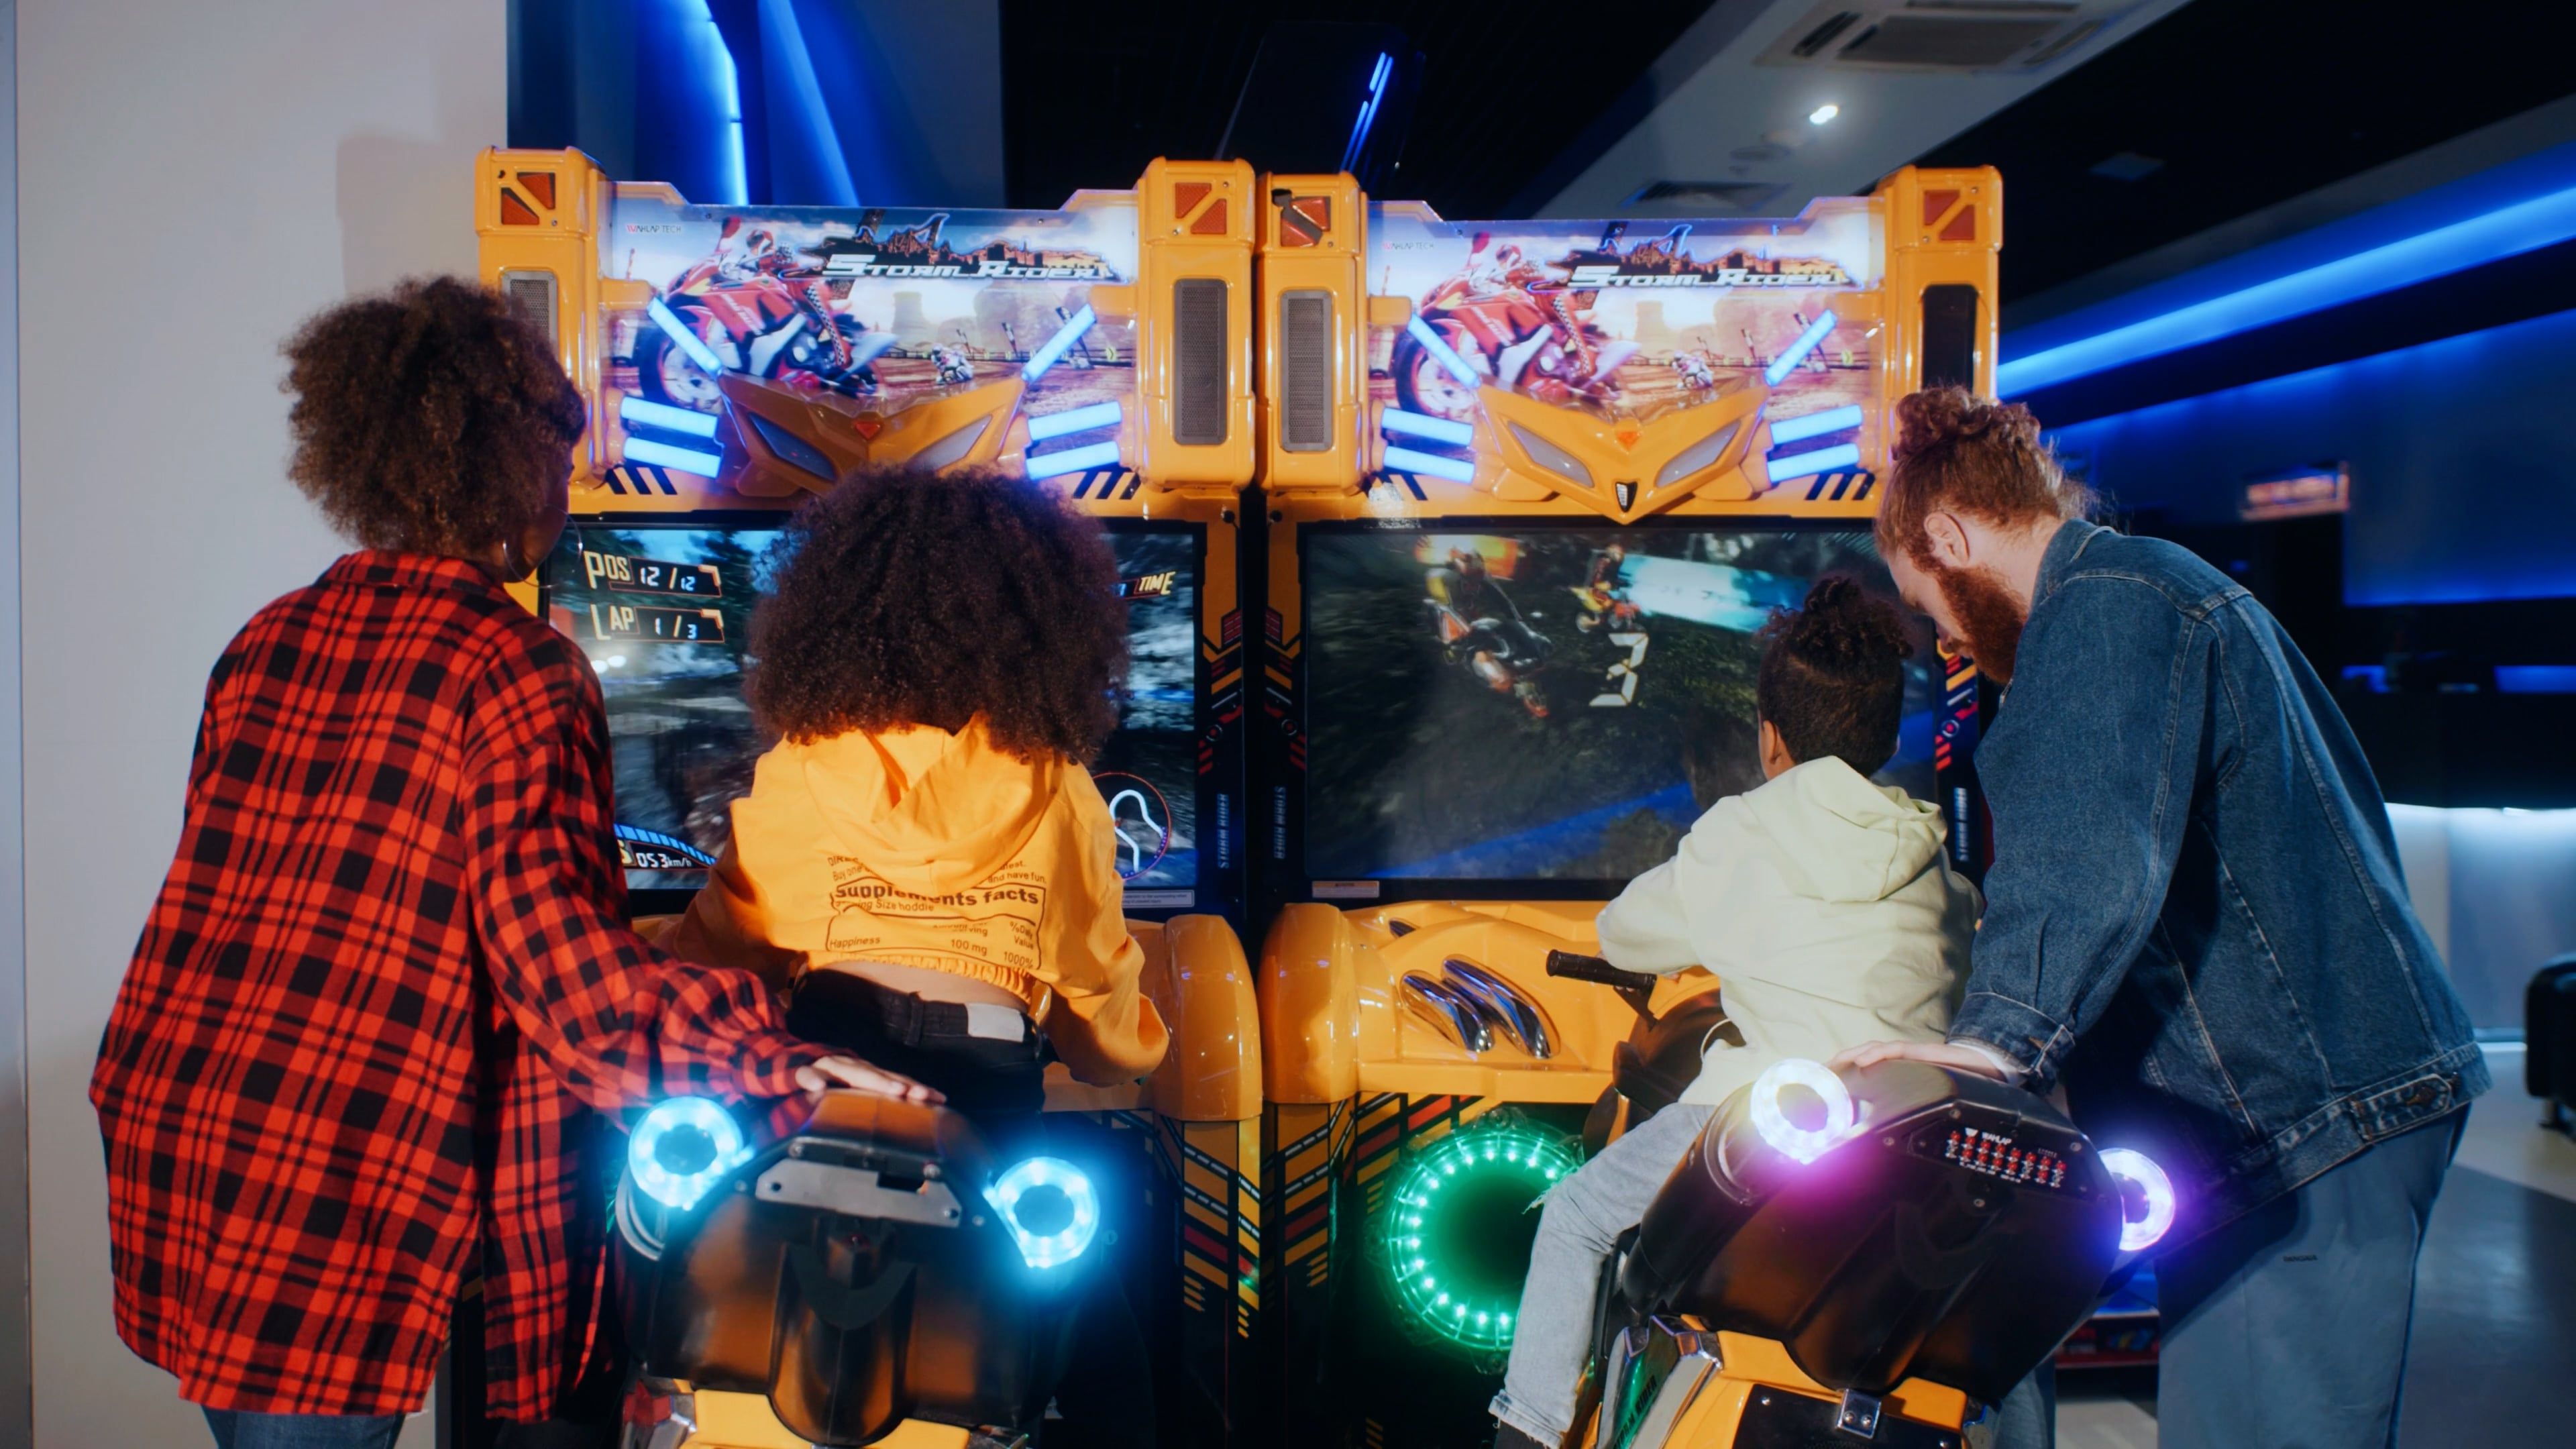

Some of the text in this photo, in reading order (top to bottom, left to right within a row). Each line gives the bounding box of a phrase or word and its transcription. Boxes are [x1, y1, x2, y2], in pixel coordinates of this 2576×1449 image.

[822, 254, 962, 279] STORM
[1568, 266, 1703, 287] STORM
[584, 551, 631, 590] POS
[1138, 572, 1176, 595] TIME
[590, 604, 635, 641] LAP
[1589, 633, 1650, 706] 3
[1007, 871, 1029, 879] have
[876, 898, 897, 910] Size
[983, 888, 1039, 904] facts
[830, 936, 881, 949] Happiness
[951, 938, 969, 951] 100
[972, 943, 987, 957] mg
[1014, 935, 1034, 950] Value
